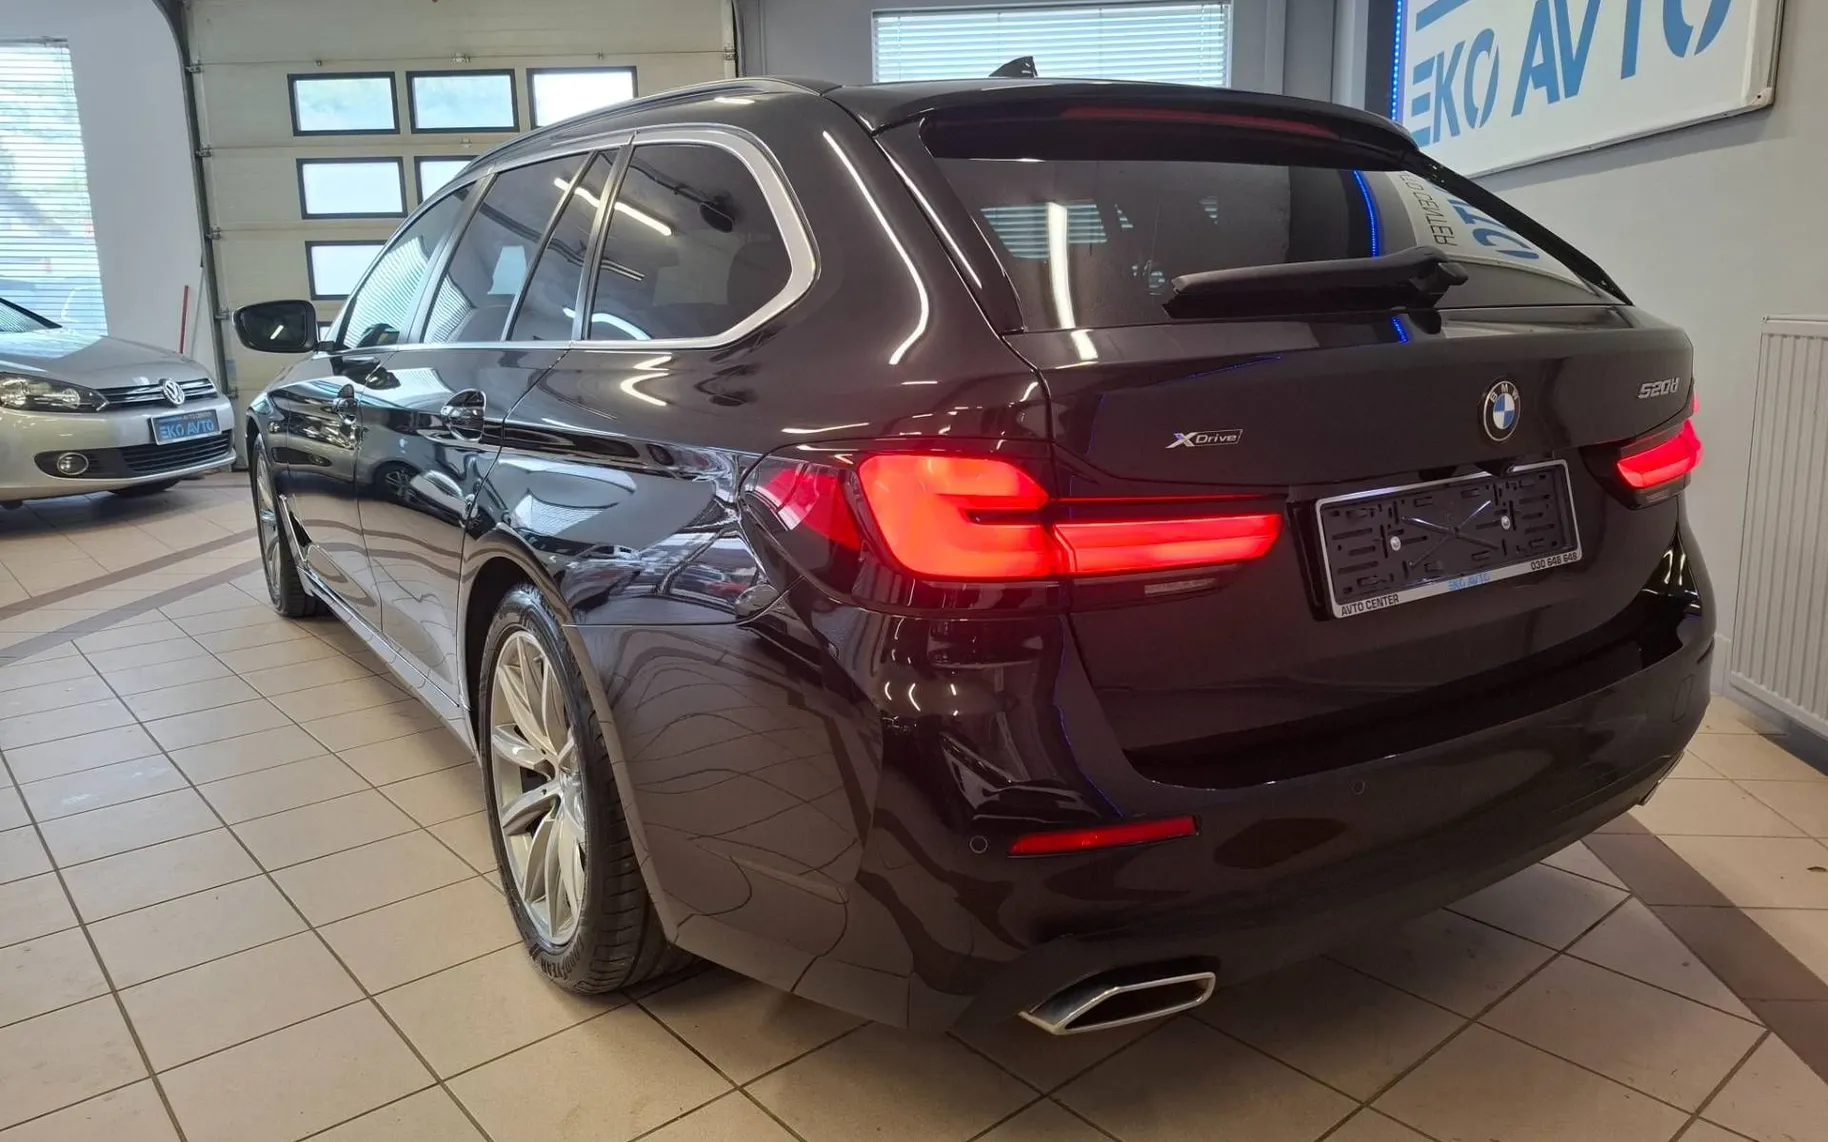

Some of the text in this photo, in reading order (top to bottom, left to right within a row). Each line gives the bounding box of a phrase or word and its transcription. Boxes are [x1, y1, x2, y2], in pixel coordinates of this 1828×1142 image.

[1411, 28, 1499, 147] EKO
[1489, 383, 1519, 403] BMW
[1638, 377, 1680, 399] 520d
[160, 419, 214, 439] EKO AVTO
[1341, 601, 1365, 616] AVTO
[1365, 593, 1400, 611] CENTER
[1531, 560, 1546, 571] 030
